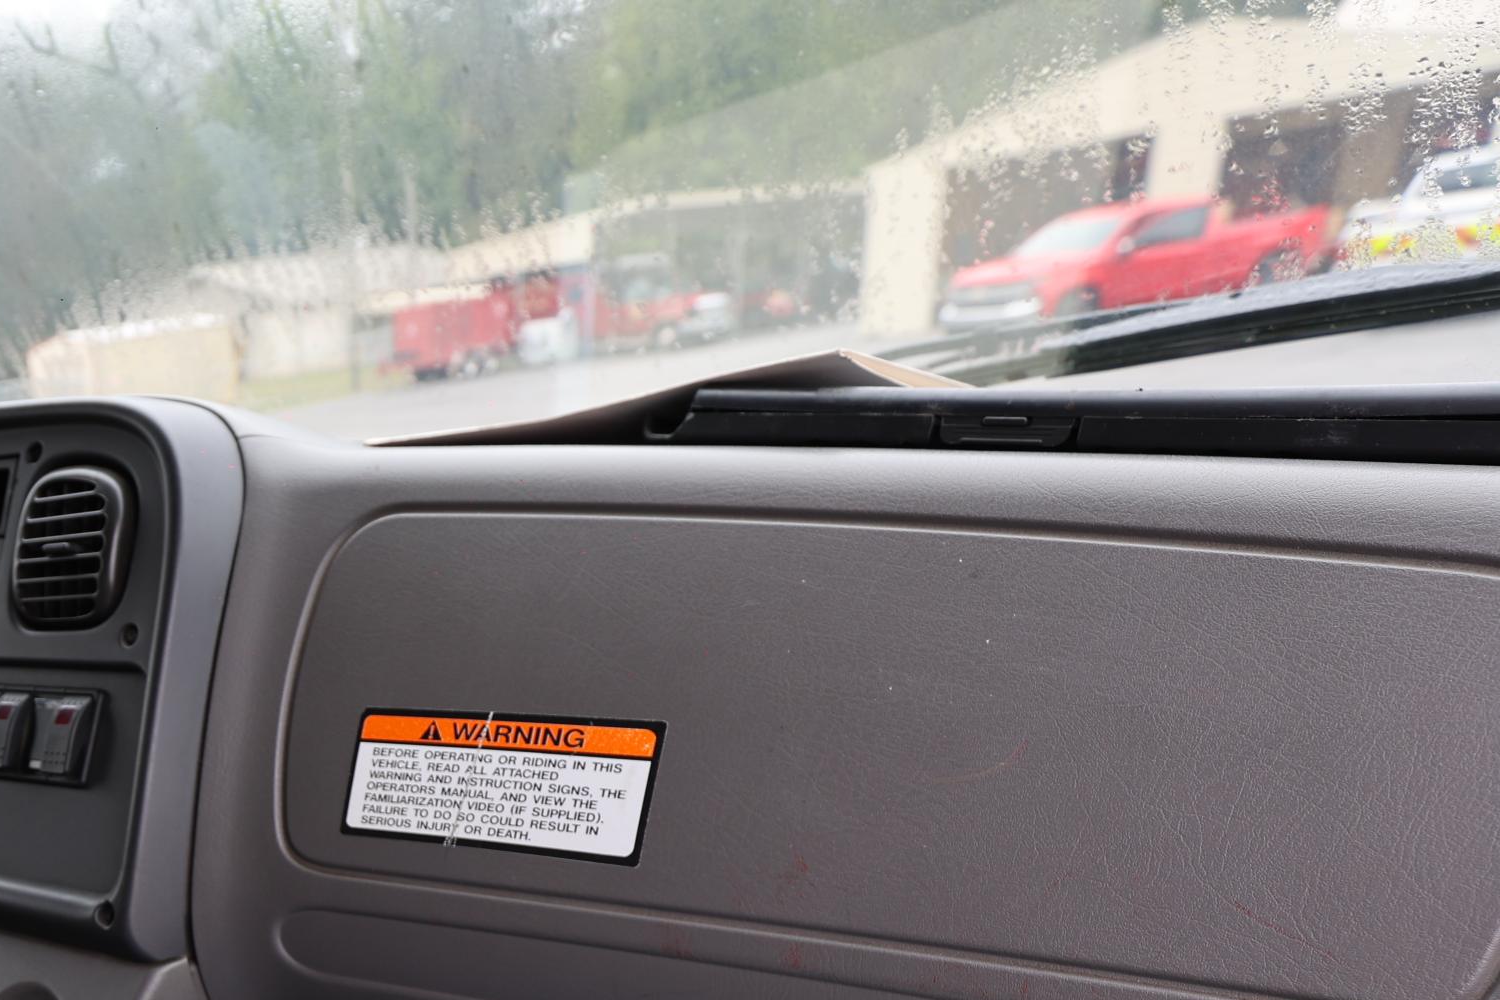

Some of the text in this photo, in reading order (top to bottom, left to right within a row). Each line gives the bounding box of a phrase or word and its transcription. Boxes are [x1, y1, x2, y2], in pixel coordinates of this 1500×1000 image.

[453, 723, 585, 748] WARNING
[372, 747, 622, 773] BEFORE OPERATING OR RIDING IN THIS
[427, 762, 460, 773] READ
[465, 765, 486, 775] ALL
[492, 767, 559, 781] ATTACHED
[366, 781, 597, 810] OPERATORS MANUAL, AND VIEW THE
[370, 770, 626, 799] WARNING AND INSTRUCTION SIGNS, THE
[362, 804, 599, 836] FAILURE TO DO SO COULD RESULT IN
[364, 792, 603, 824] FAMILIARIZATION VIDEO (IF SUPPLIED).
[361, 815, 411, 828] SERIOUS
[464, 825, 482, 835] OR
[487, 827, 530, 840] DEATH.
